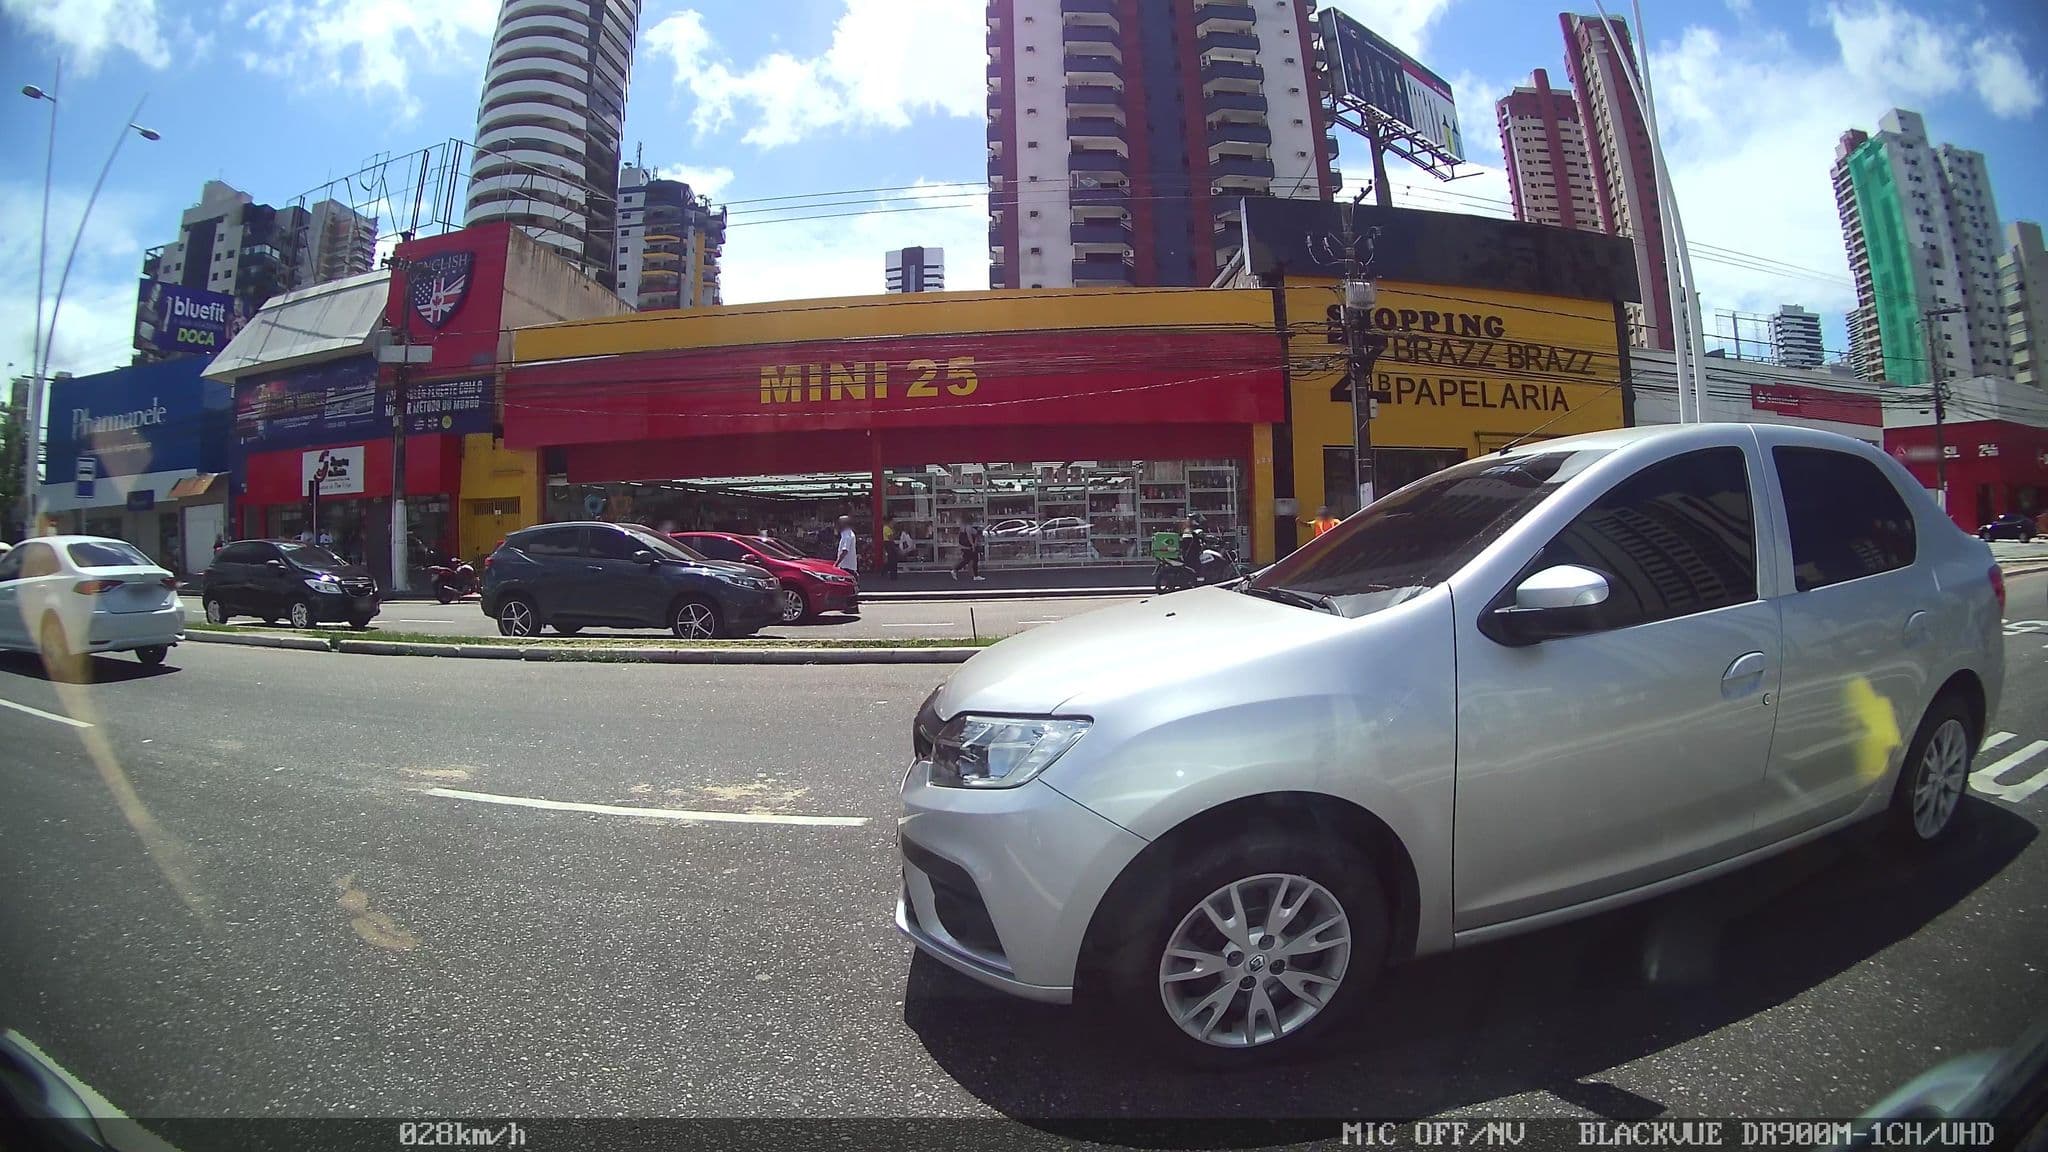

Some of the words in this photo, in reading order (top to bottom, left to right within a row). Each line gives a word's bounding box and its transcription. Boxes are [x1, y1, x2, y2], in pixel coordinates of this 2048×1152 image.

[174, 296, 225, 323] bluefit
[1326, 304, 1506, 338] SOPPING
[177, 327, 215, 346] DOCA
[1393, 333, 1497, 369] BRAZZ
[1507, 343, 1596, 376] BRAZZ
[760, 361, 888, 404] MINI
[906, 356, 978, 397] 25
[1397, 376, 1570, 412] PAPELARIA
